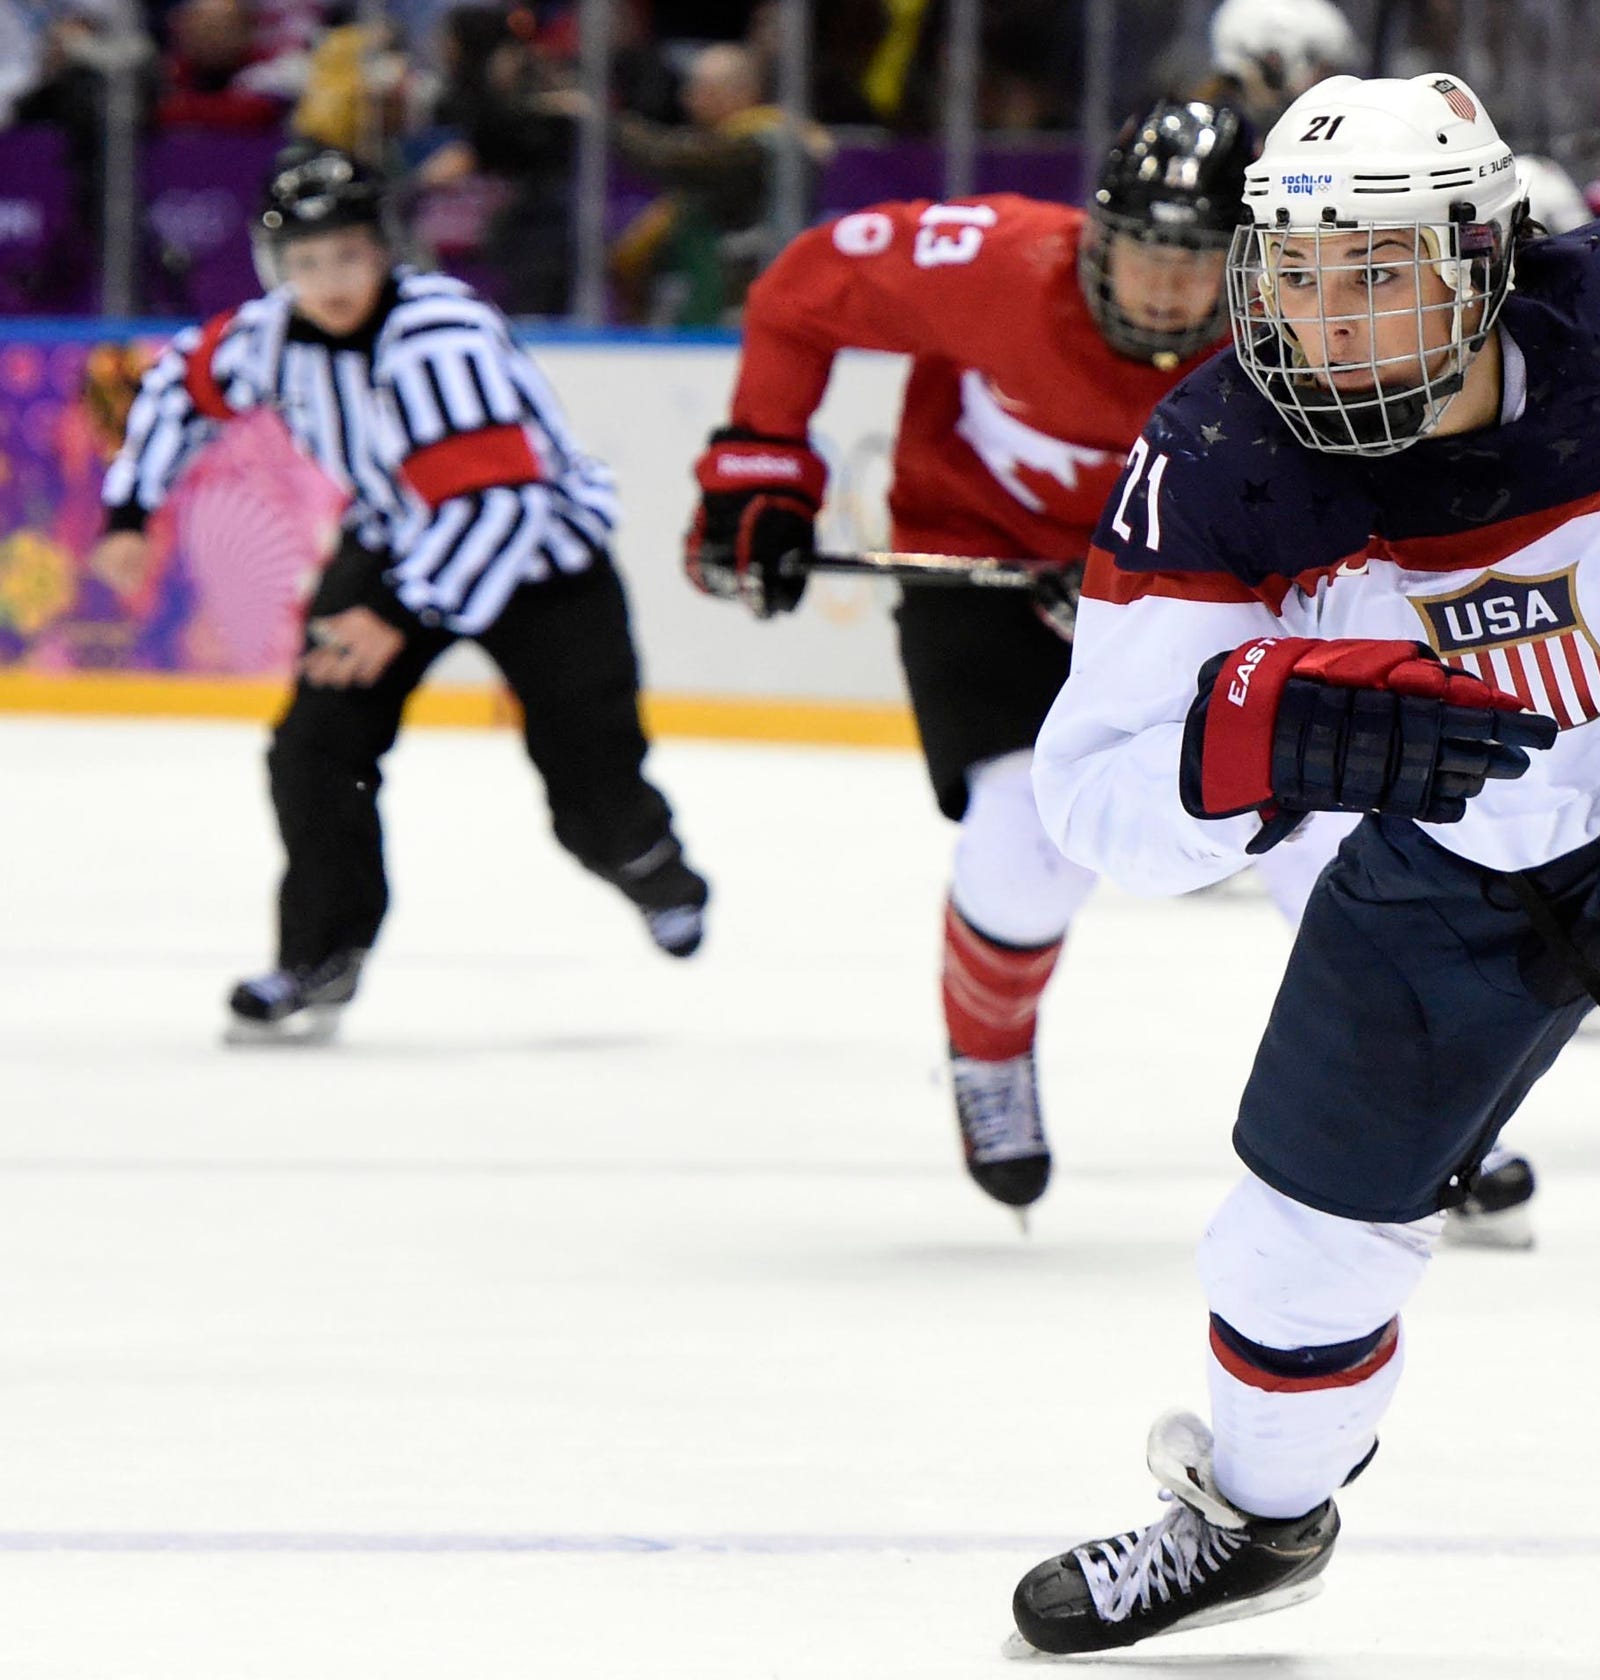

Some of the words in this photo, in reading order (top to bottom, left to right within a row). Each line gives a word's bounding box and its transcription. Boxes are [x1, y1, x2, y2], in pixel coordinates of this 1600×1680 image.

[1300, 115, 1345, 142] 21
[1281, 173, 1332, 185] sochi.ru
[1287, 185, 1313, 196] 2014
[913, 203, 999, 270] 13
[1111, 435, 1169, 552] 21
[1444, 588, 1559, 642] USA
